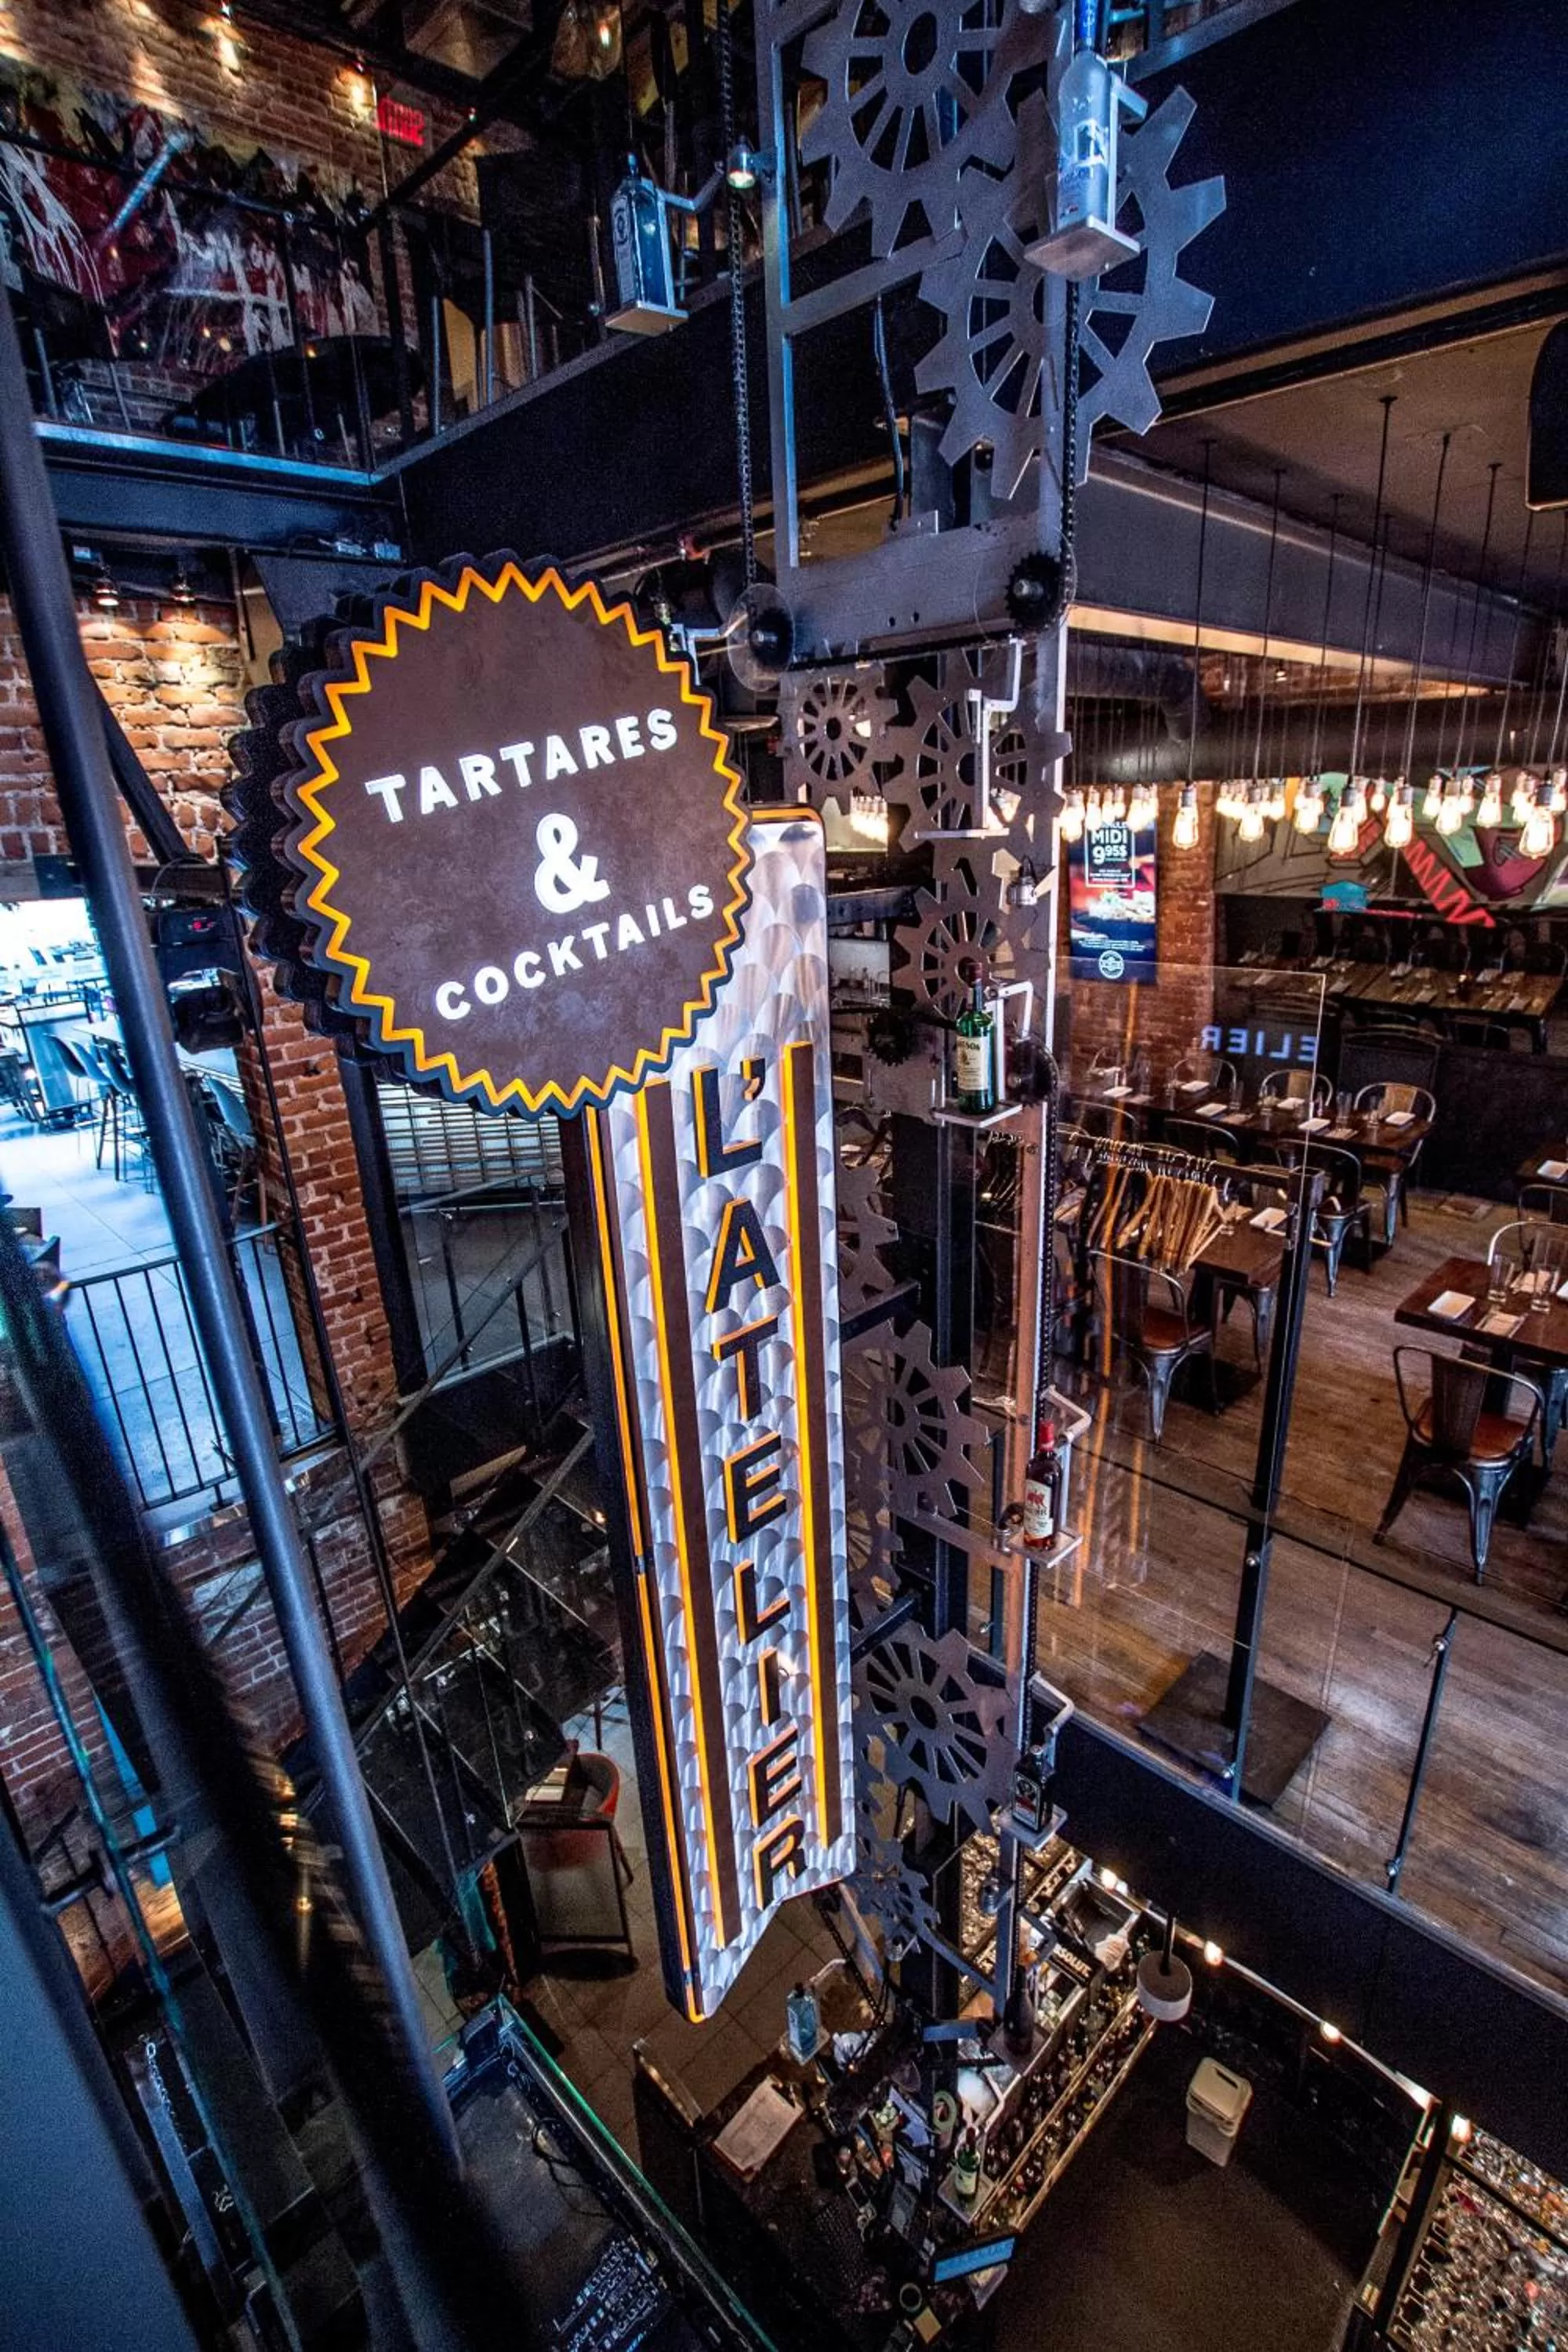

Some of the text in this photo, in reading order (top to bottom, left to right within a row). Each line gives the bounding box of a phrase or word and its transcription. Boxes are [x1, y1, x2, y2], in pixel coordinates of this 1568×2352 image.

[365, 708, 678, 822] TARTARES
[534, 812, 610, 914] &
[1091, 829, 1127, 844] MIDI
[435, 884, 714, 1020] COCKTAILS
[690, 1054, 808, 1911] L'ATELIER
